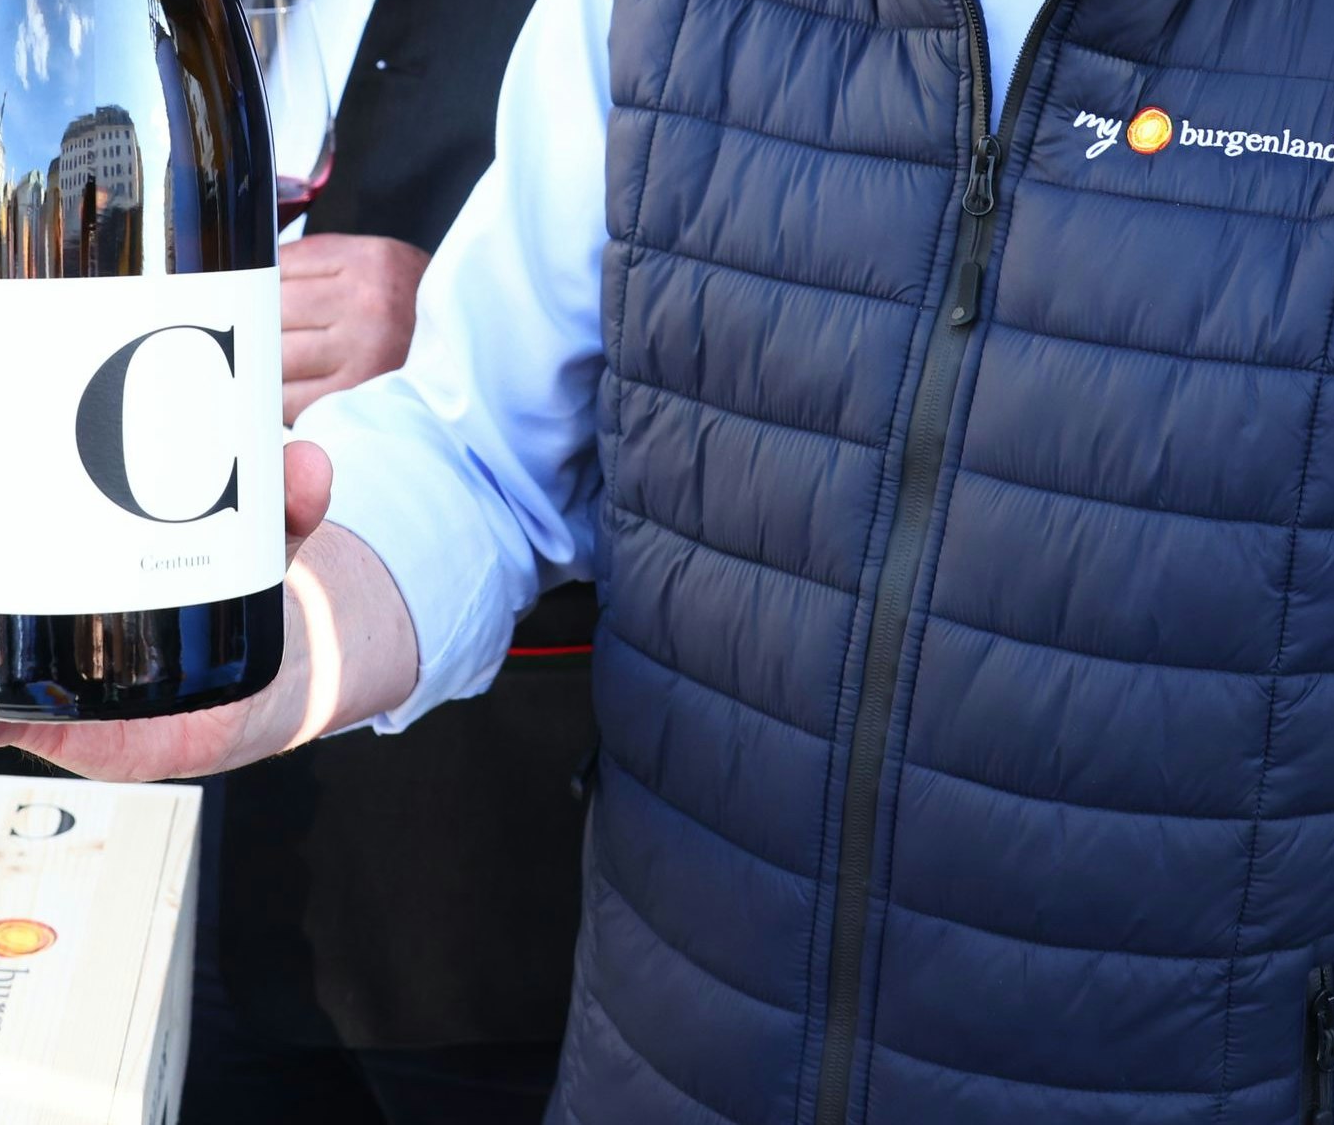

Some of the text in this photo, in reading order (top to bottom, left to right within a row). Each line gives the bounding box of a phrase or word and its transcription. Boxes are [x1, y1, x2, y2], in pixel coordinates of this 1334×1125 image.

[1073, 110, 1122, 159] my
[75, 325, 238, 523] C
[140, 555, 211, 571] Centum
[9, 802, 76, 840] C
